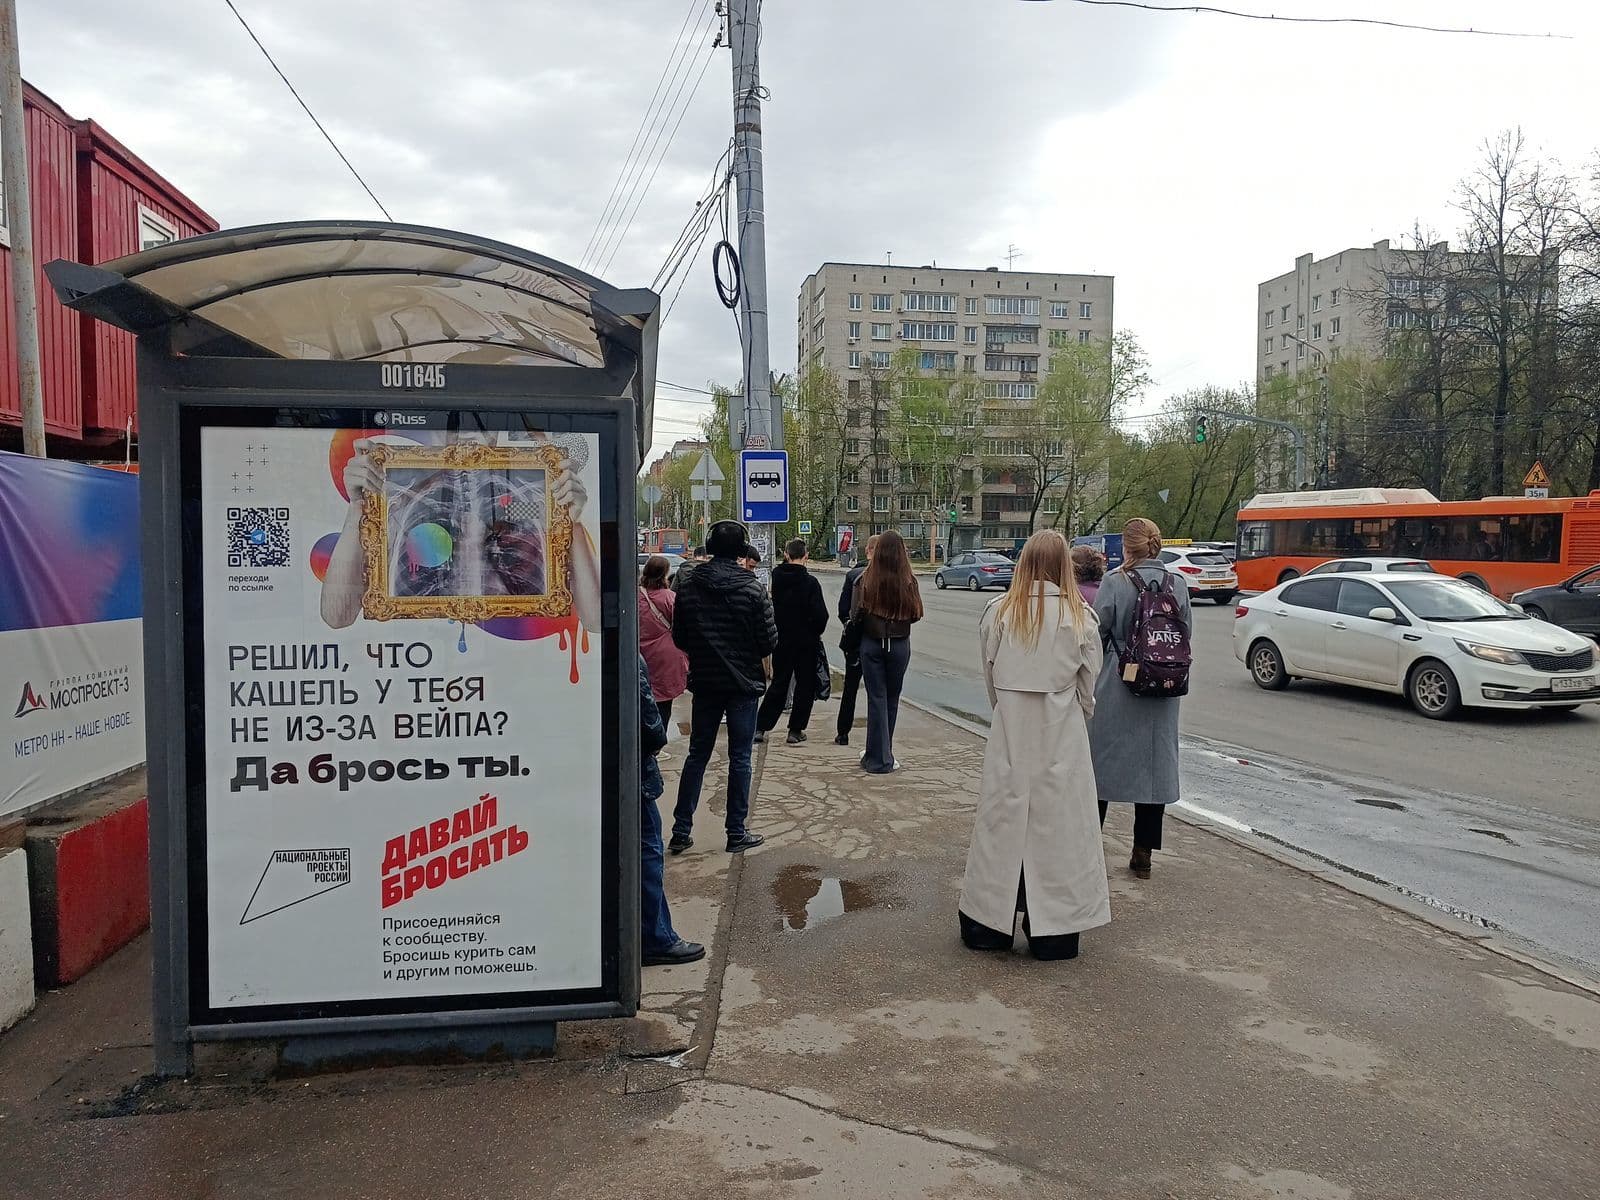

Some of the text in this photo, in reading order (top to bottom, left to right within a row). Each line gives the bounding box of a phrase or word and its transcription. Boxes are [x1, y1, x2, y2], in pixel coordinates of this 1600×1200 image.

[391, 412, 427, 425] Russ
[228, 574, 270, 585] переходи
[1147, 629, 1182, 644] VANS
[228, 641, 433, 673] РЕШИЛ, ЧТО
[50, 676, 130, 710] МОСПРОЕКТ-3
[229, 679, 359, 708] КАШЕЛЬ
[375, 678, 393, 705] У
[230, 706, 509, 744] НЕ ИЗ-ЗА ВЕЙПА?
[14, 734, 49, 758] МЕТРО
[51, 730, 65, 747] НН
[75, 719, 101, 741] НАШЕ
[230, 753, 531, 793] Да брось ты.
[381, 793, 498, 876] ДАВАЙ
[275, 851, 348, 864] НАЦИОНАЛЬНЫЕ
[306, 861, 348, 873] ПРОЕКТЫ
[381, 824, 529, 909] БРОСАТЬ
[314, 871, 348, 884] РОССИИ
[382, 911, 502, 932] Присоединяйся
[382, 930, 488, 947] к сообществу.
[383, 945, 537, 965] Бросишь курить сам
[383, 962, 538, 981] и другим поможешь.
